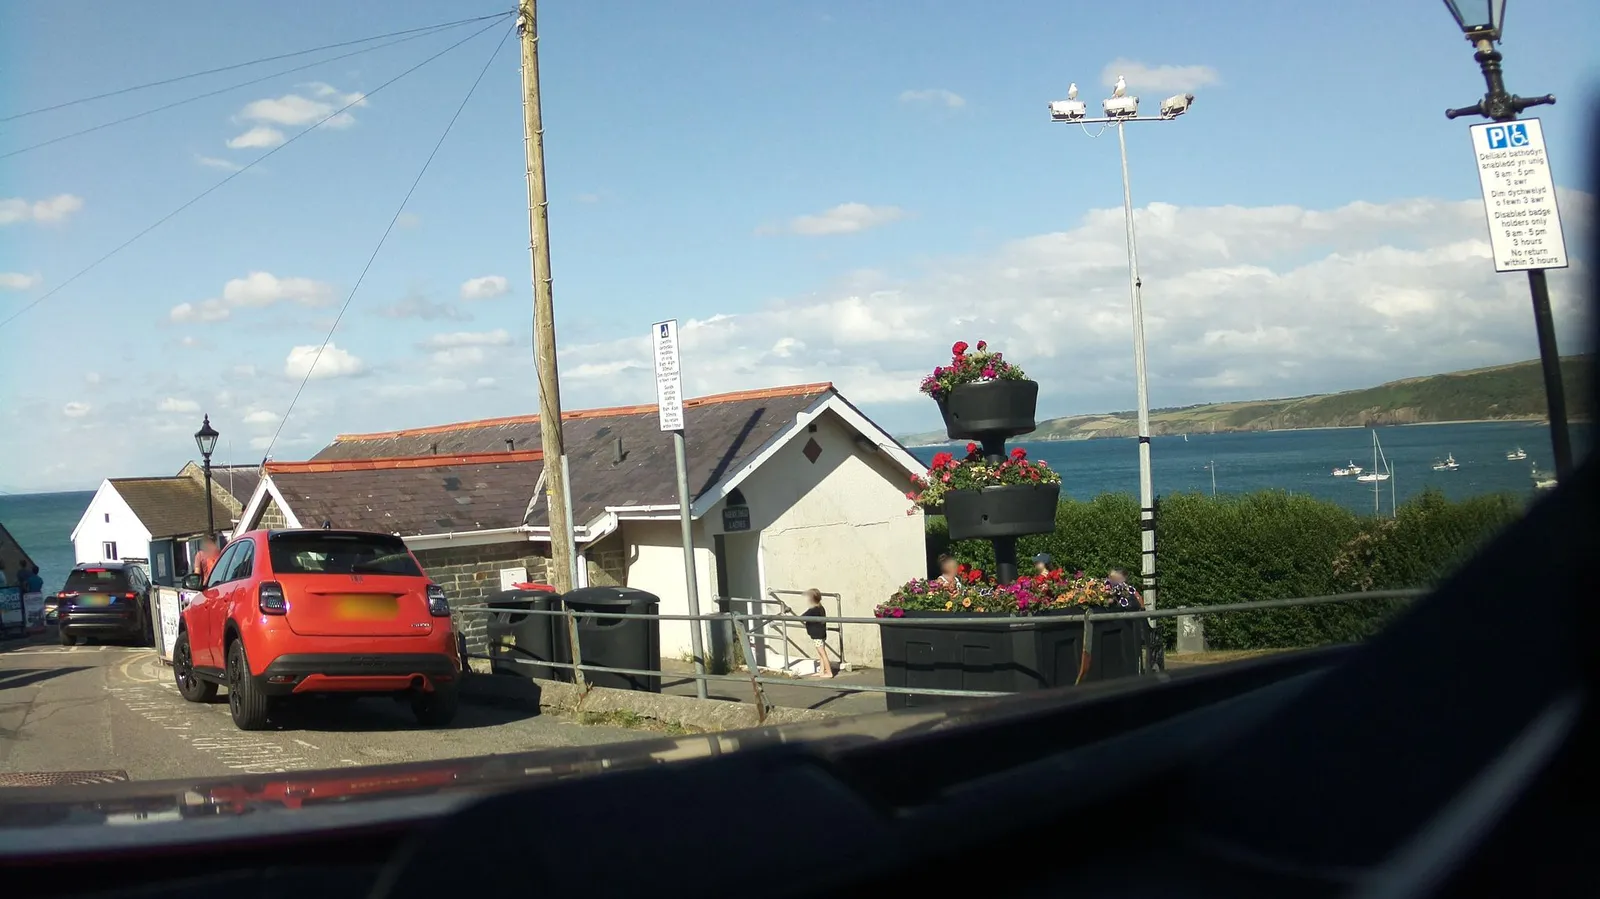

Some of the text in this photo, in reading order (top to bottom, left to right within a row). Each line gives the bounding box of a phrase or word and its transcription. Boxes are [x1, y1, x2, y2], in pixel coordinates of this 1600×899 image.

[1489, 128, 1504, 148] P
[1479, 148, 1543, 161] Deiliaid bathodyn
[1482, 157, 1544, 169] anabledd yn unig
[1505, 178, 1511, 186] 3
[1491, 187, 1547, 198] Dim dychwelyd
[1503, 198, 1521, 206] fewn
[1523, 196, 1529, 204] 3
[1530, 196, 1544, 204] awr
[1494, 208, 1551, 219] Disabled badge
[1501, 217, 1547, 227] holders only
[1512, 238, 1542, 246] 3 hours
[1510, 248, 1549, 257] No return
[1503, 256, 1559, 267] within 3 hours
